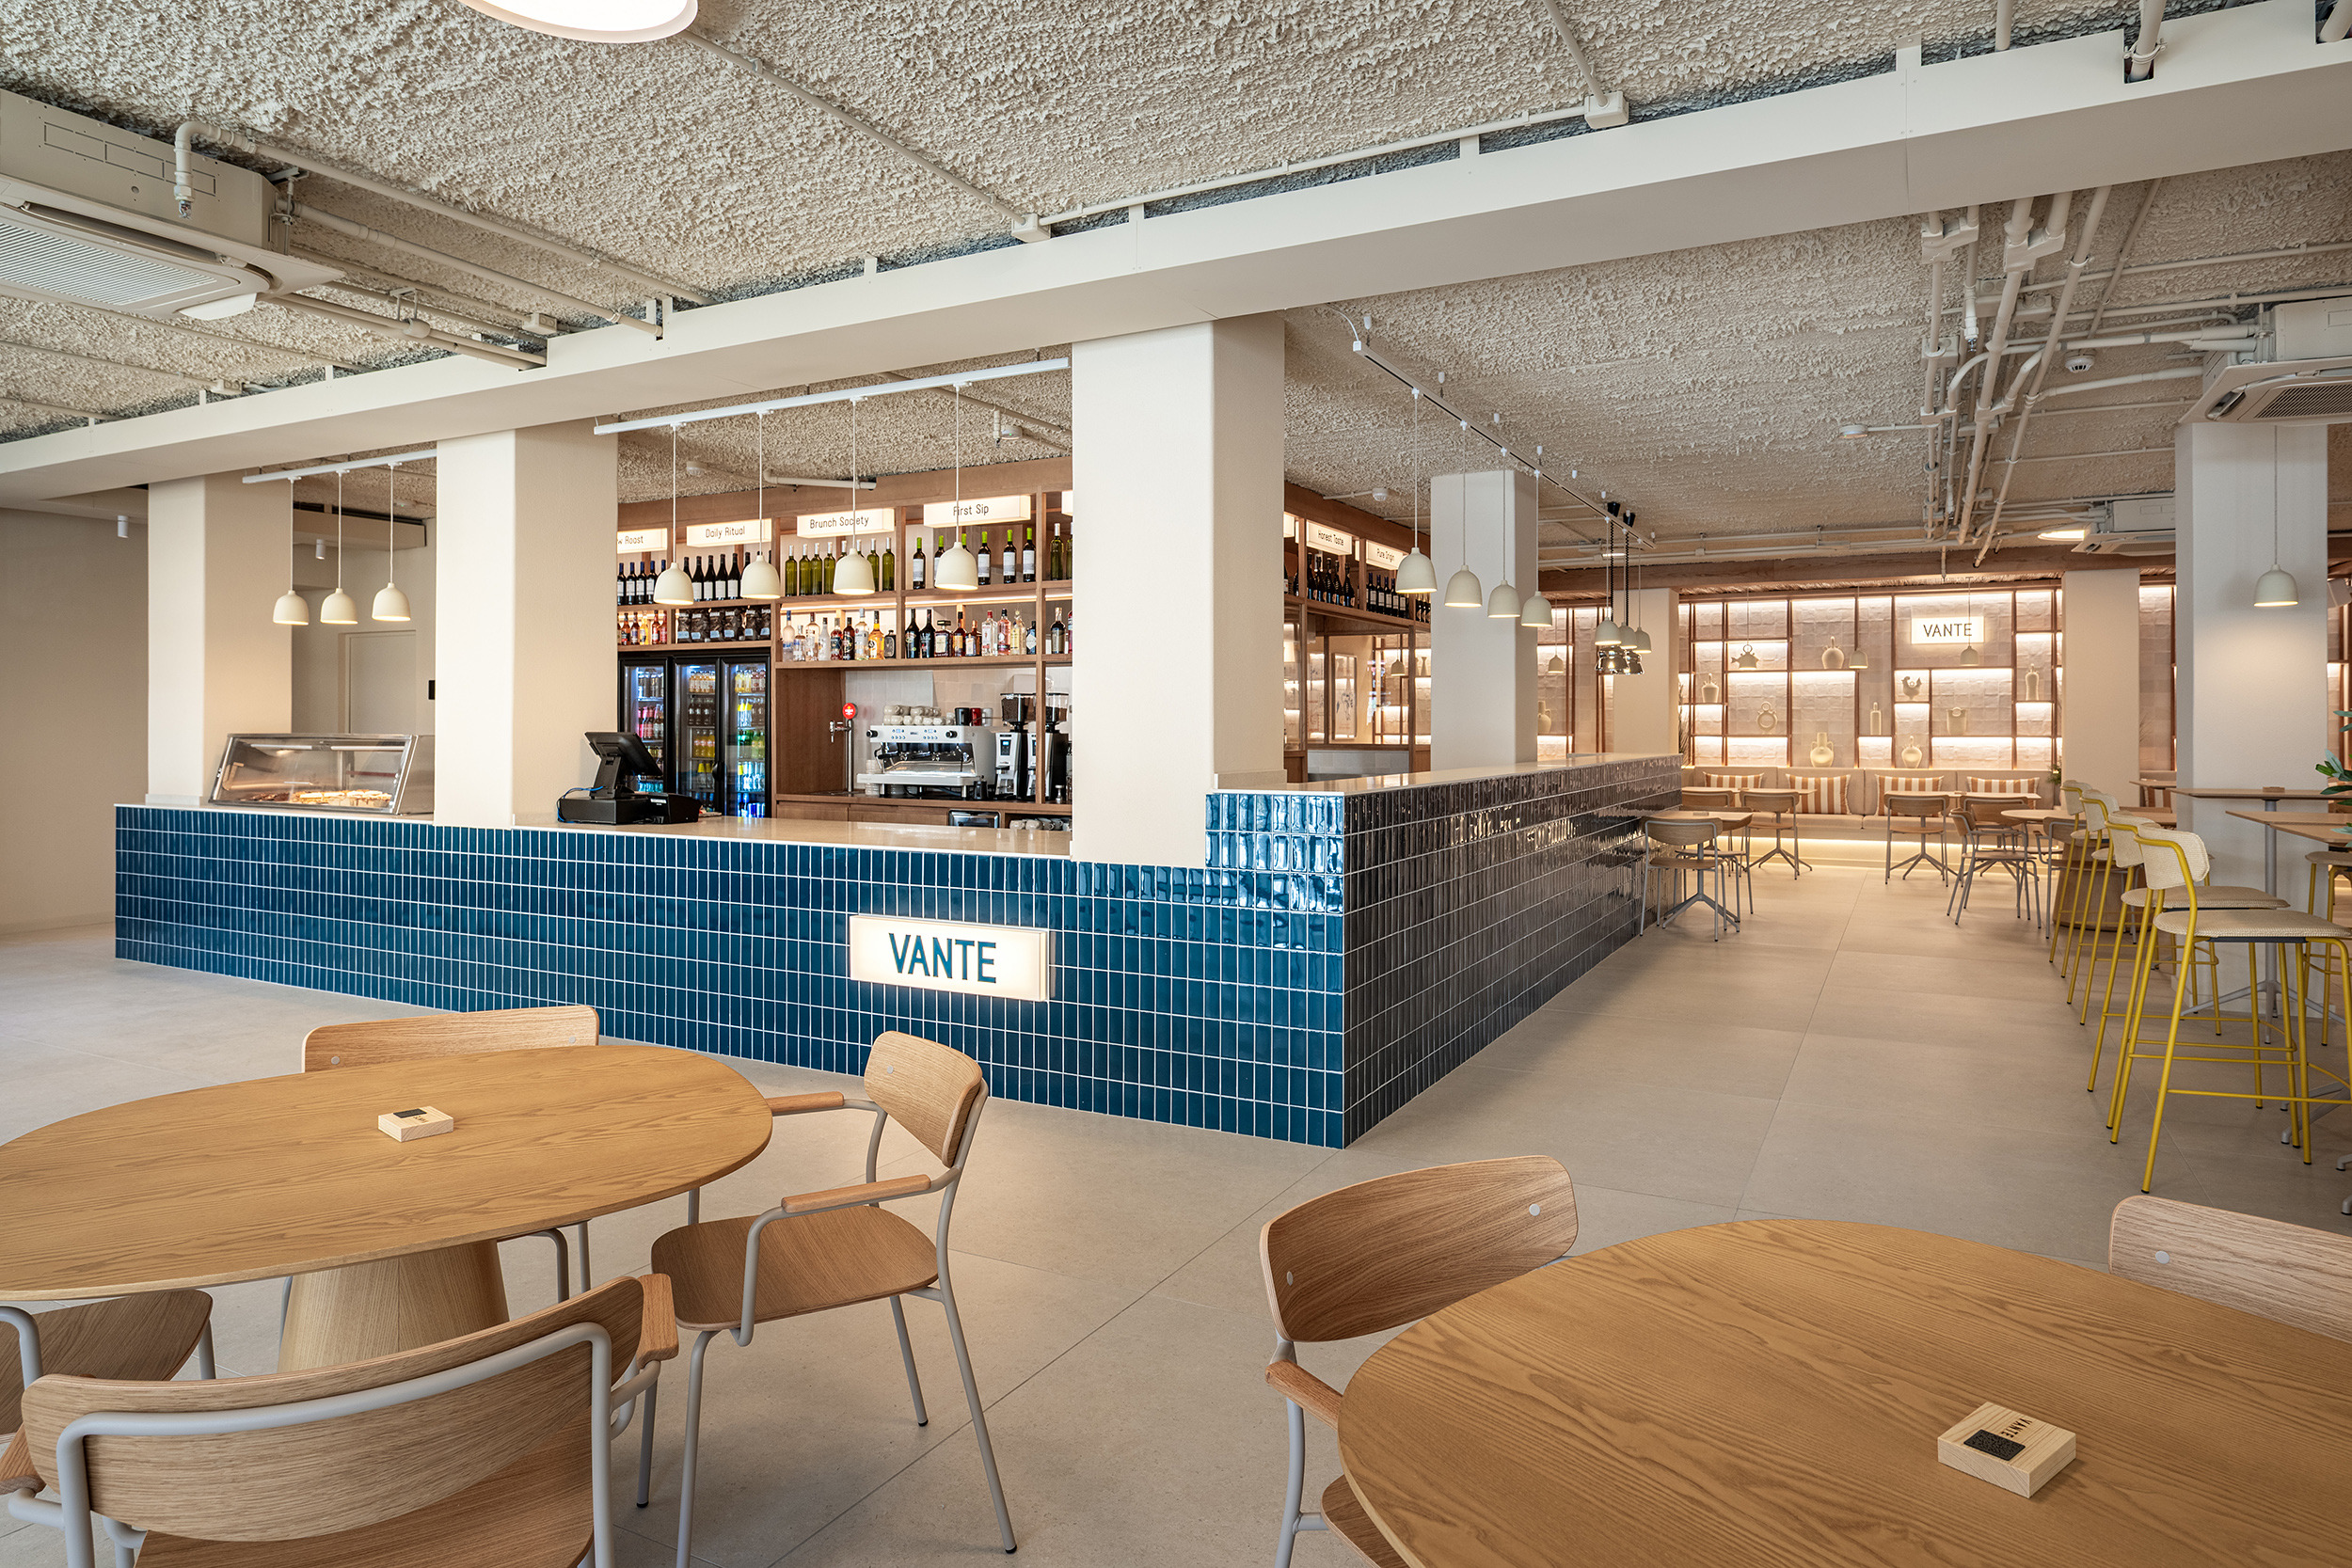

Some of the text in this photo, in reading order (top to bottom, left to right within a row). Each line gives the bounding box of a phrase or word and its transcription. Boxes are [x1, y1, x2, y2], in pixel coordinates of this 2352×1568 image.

[976, 503, 990, 515] Sip
[810, 516, 869, 529] Brunch Socety
[706, 526, 745, 539] Daily Ritual
[1318, 530, 1343, 546] Honest Taste
[625, 535, 644, 545] Roast
[1923, 623, 1972, 637] VANTE
[888, 932, 996, 984] VANTE
[2001, 1418, 2032, 1438] VANTE
